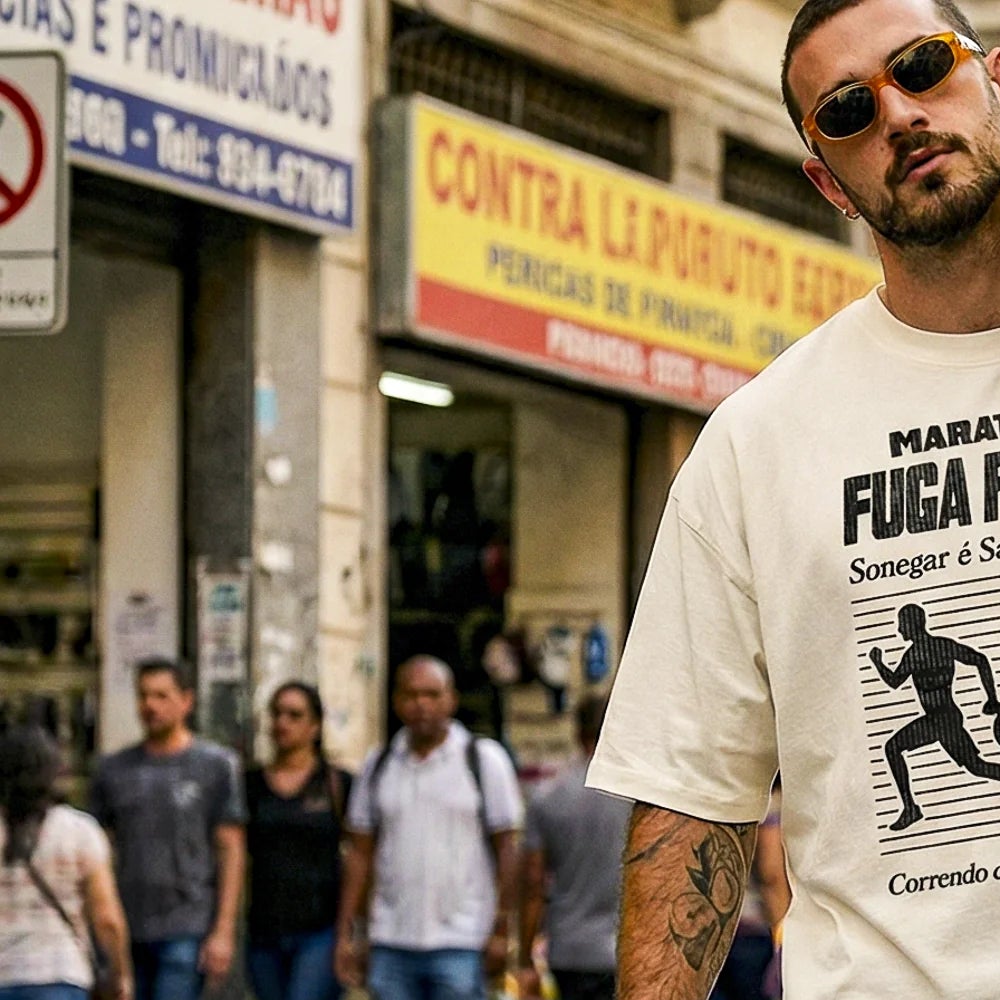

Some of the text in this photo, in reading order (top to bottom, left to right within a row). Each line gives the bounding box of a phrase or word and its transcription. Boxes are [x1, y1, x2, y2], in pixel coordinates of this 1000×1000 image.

[427, 129, 590, 252] CONTRA
[843, 457, 973, 546] FUGA
[849, 552, 950, 585] Sonegar
[958, 541, 972, 565] é
[888, 862, 989, 896] Correndo
